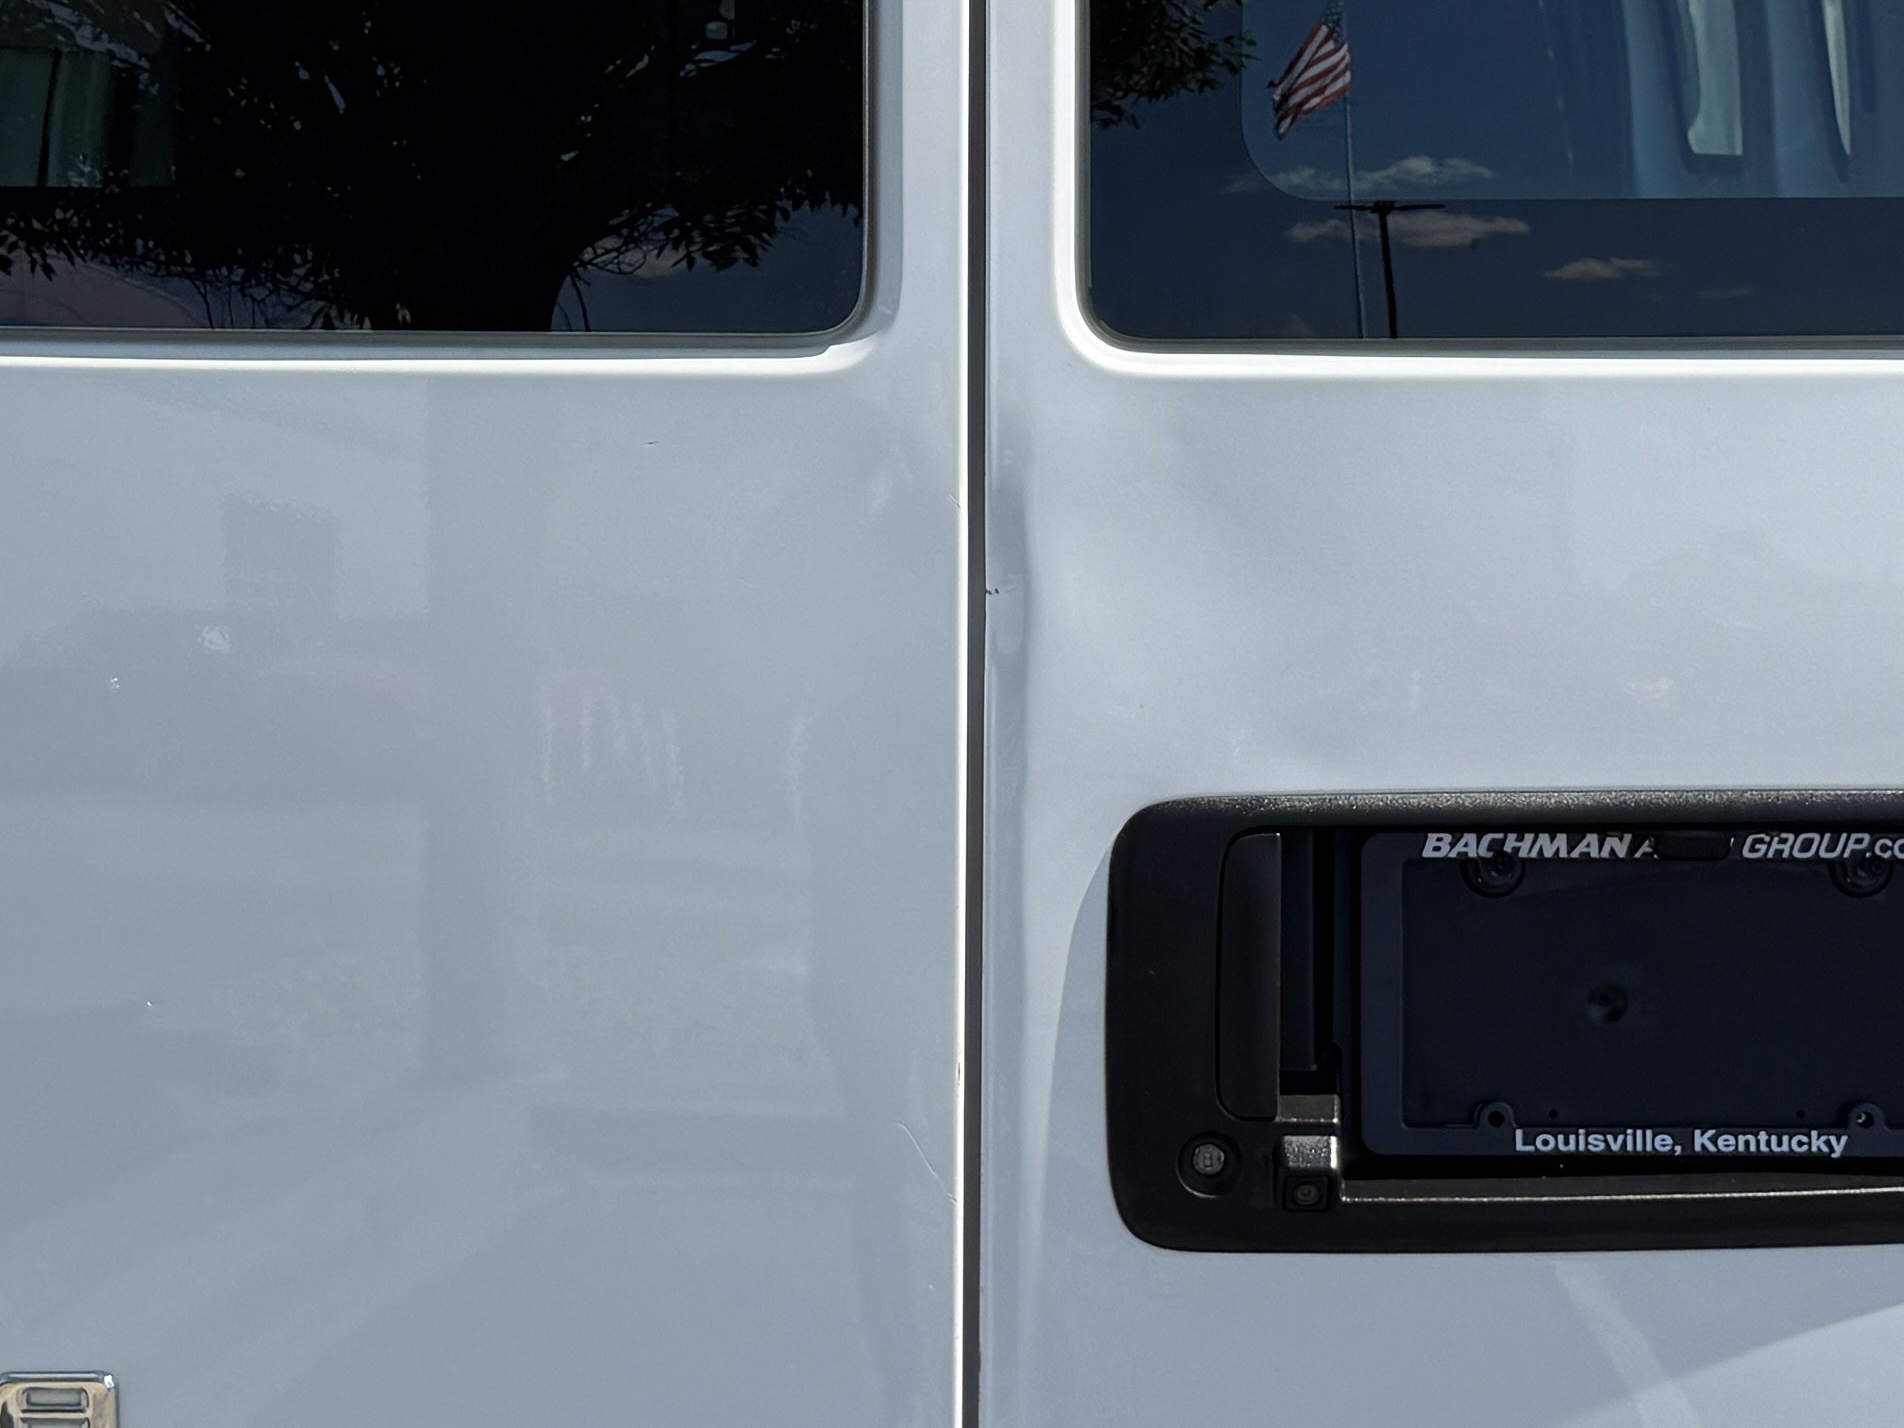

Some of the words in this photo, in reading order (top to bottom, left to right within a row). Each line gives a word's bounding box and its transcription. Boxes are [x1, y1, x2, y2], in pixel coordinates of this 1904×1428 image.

[1421, 832, 1633, 859] BACHMAN
[1514, 1128, 1683, 1156] Louisville,
[1693, 1128, 1849, 1158] Kentucky
